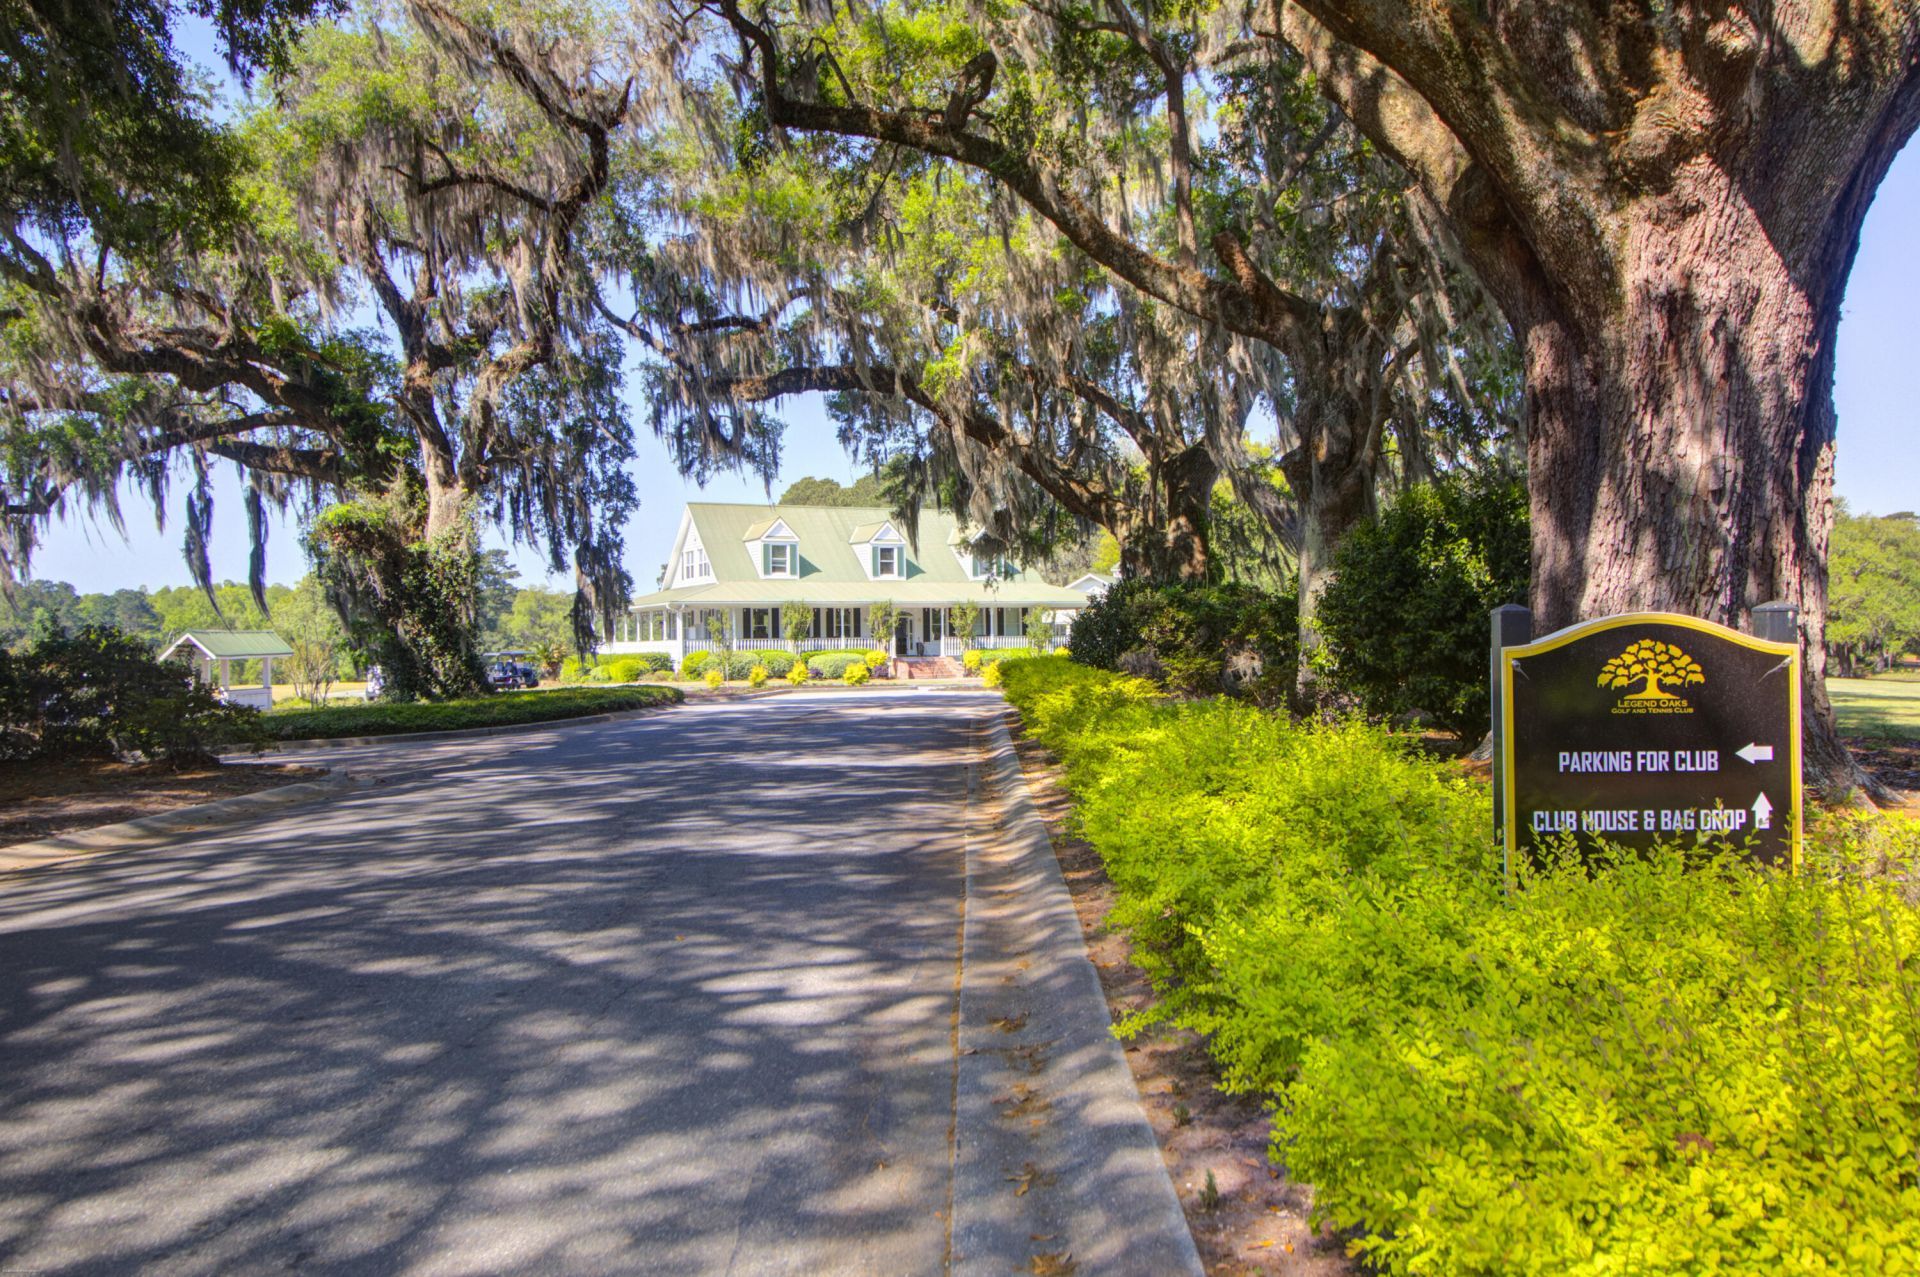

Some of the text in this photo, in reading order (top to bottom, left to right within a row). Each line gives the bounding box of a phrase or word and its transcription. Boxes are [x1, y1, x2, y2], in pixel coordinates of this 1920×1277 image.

[1617, 699, 1688, 708] LEGEND OAKS
[1558, 750, 1719, 772] PARKING FOR CLUB
[1533, 809, 1747, 832] CLUB HOUSE & BAG DROP
